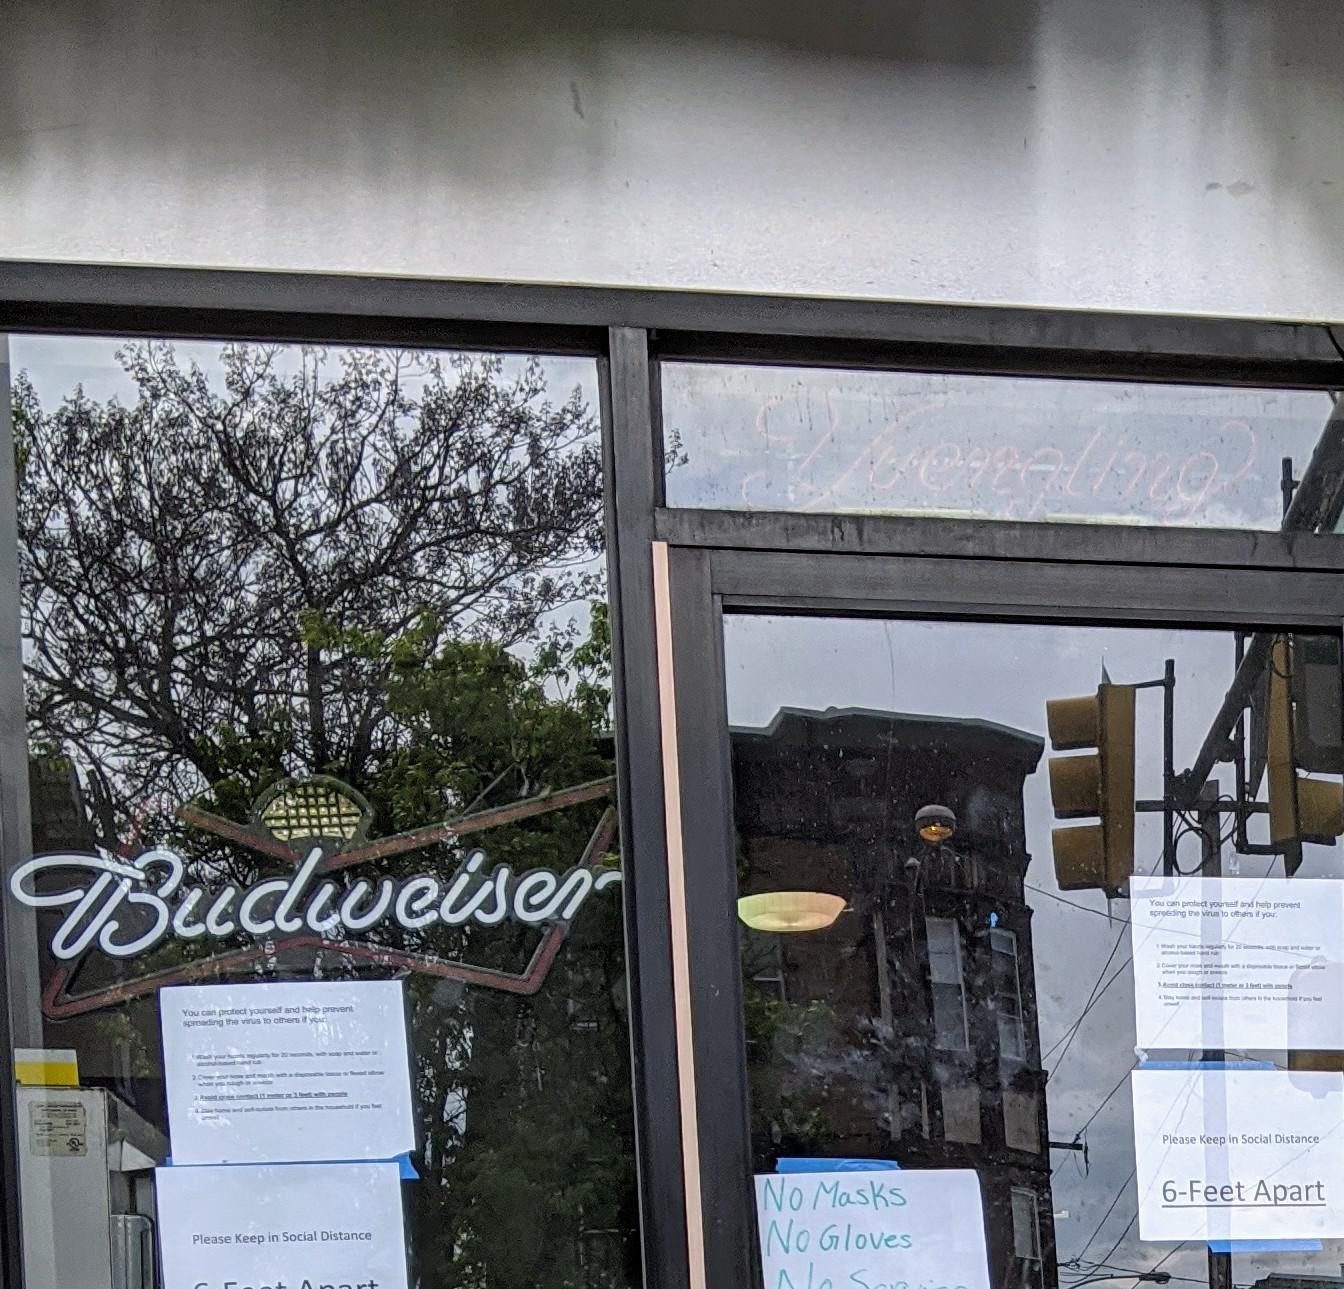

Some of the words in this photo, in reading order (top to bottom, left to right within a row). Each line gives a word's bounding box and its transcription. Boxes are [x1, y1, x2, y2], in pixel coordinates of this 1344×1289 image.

[9, 847, 623, 961] Budweiser
[1150, 899, 1164, 908] You
[1166, 900, 1180, 908] can
[1182, 899, 1207, 909] protect
[1209, 900, 1238, 910] yourself
[1240, 900, 1254, 908] and
[1256, 901, 1271, 910] help
[1273, 902, 1301, 910] prevent
[1150, 909, 1186, 919] spreading
[1188, 909, 1200, 917] the
[1202, 910, 1219, 918] virus
[1230, 910, 1254, 918] others
[182, 1008, 199, 1018] You
[202, 1009, 216, 1017] can
[218, 1007, 247, 1018] protect
[249, 1006, 282, 1017] yourself
[284, 1006, 300, 1015] and
[322, 1005, 354, 1015] prevent
[226, 1017, 239, 1026] the
[241, 1017, 261, 1025] virus
[263, 1016, 272, 1025] to
[273, 1016, 300, 1025] others
[1162, 1134, 1196, 1145] Please
[1199, 1134, 1226, 1146] Keep
[1228, 1134, 1238, 1144] in
[1241, 1133, 1272, 1144] Social
[1275, 1133, 1320, 1144] Distance
[763, 1177, 803, 1212] No
[812, 1179, 908, 1212] Masks
[1162, 1179, 1246, 1203] 6-Feet
[1253, 1179, 1326, 1206] Apart
[192, 1233, 232, 1245] Please
[234, 1233, 265, 1245] Keep
[268, 1232, 279, 1242] in
[282, 1230, 317, 1242] Social
[320, 1230, 372, 1241] Distance
[767, 1218, 810, 1257] No
[819, 1223, 913, 1252] Gloves
